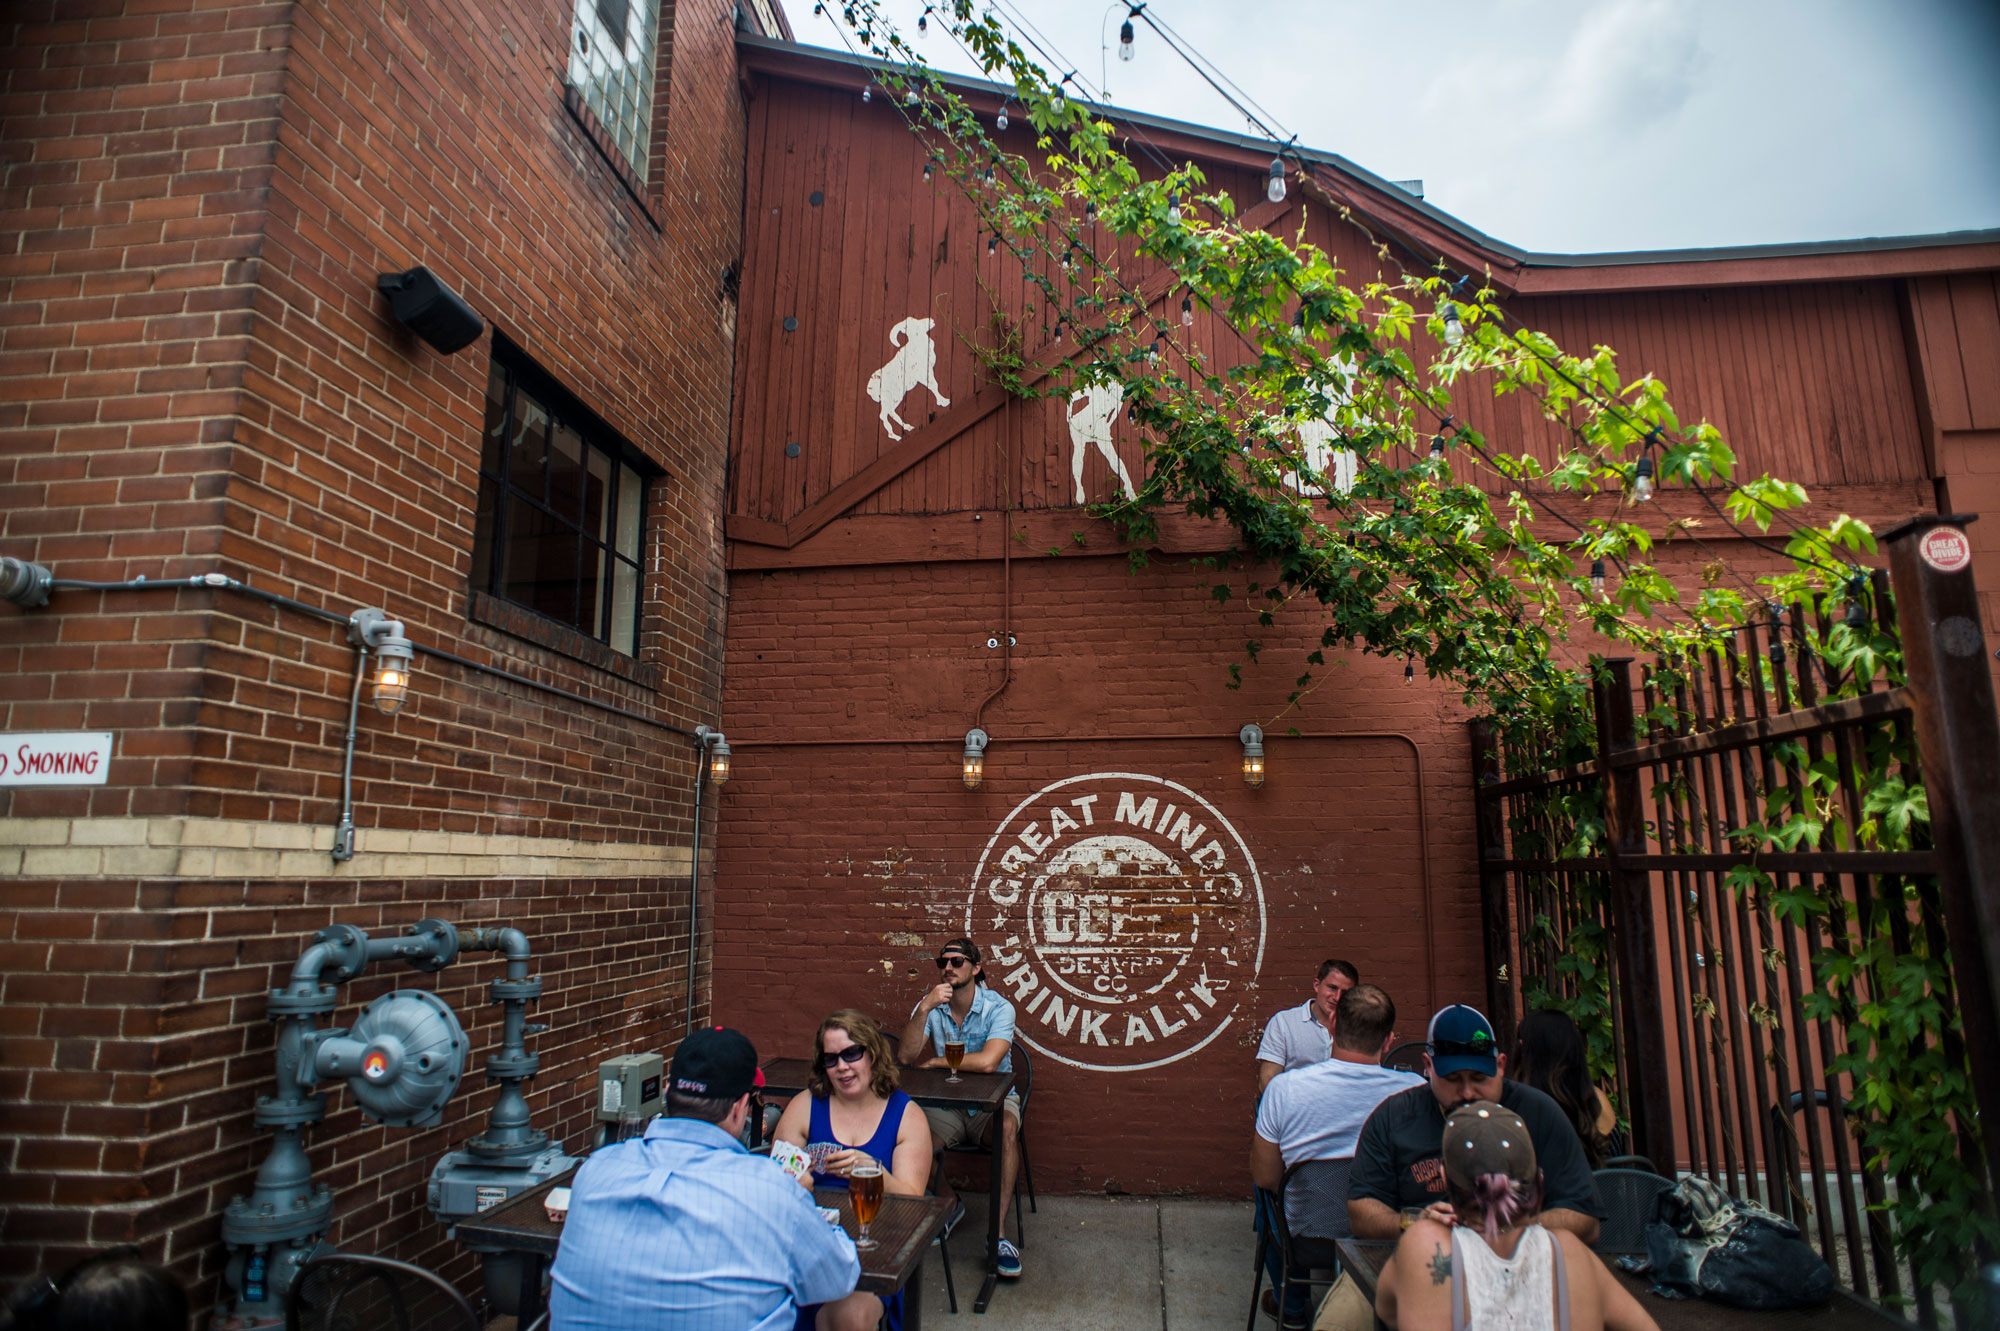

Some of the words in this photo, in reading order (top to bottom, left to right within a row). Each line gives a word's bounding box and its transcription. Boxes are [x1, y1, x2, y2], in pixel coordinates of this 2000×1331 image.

[13, 744, 99, 775] SMOKING
[988, 794, 1099, 906] GREAT
[991, 935, 1113, 1047] DRINK
